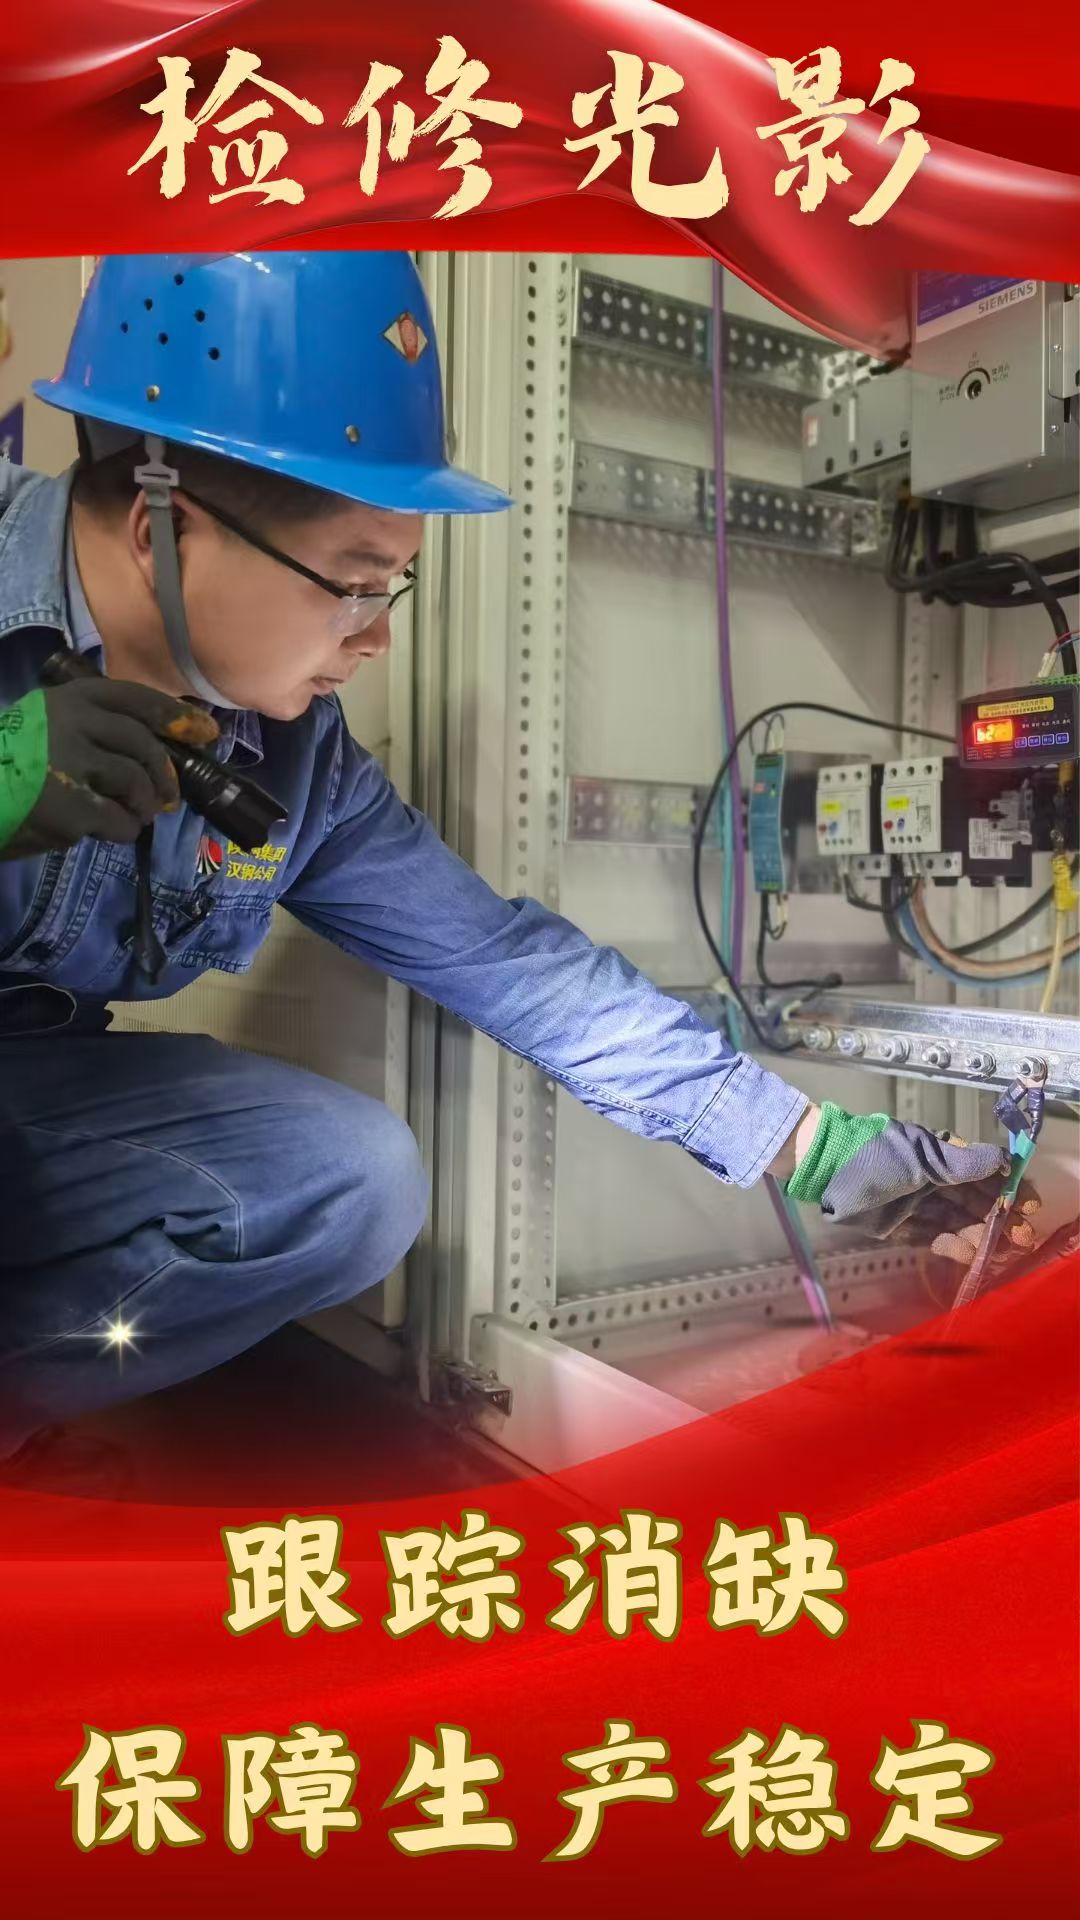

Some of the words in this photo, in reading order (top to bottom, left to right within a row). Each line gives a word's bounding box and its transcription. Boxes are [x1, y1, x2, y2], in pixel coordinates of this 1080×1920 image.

[978, 282, 1034, 314] SIEMENS
[226, 860, 277, 881] 汉钢公司
